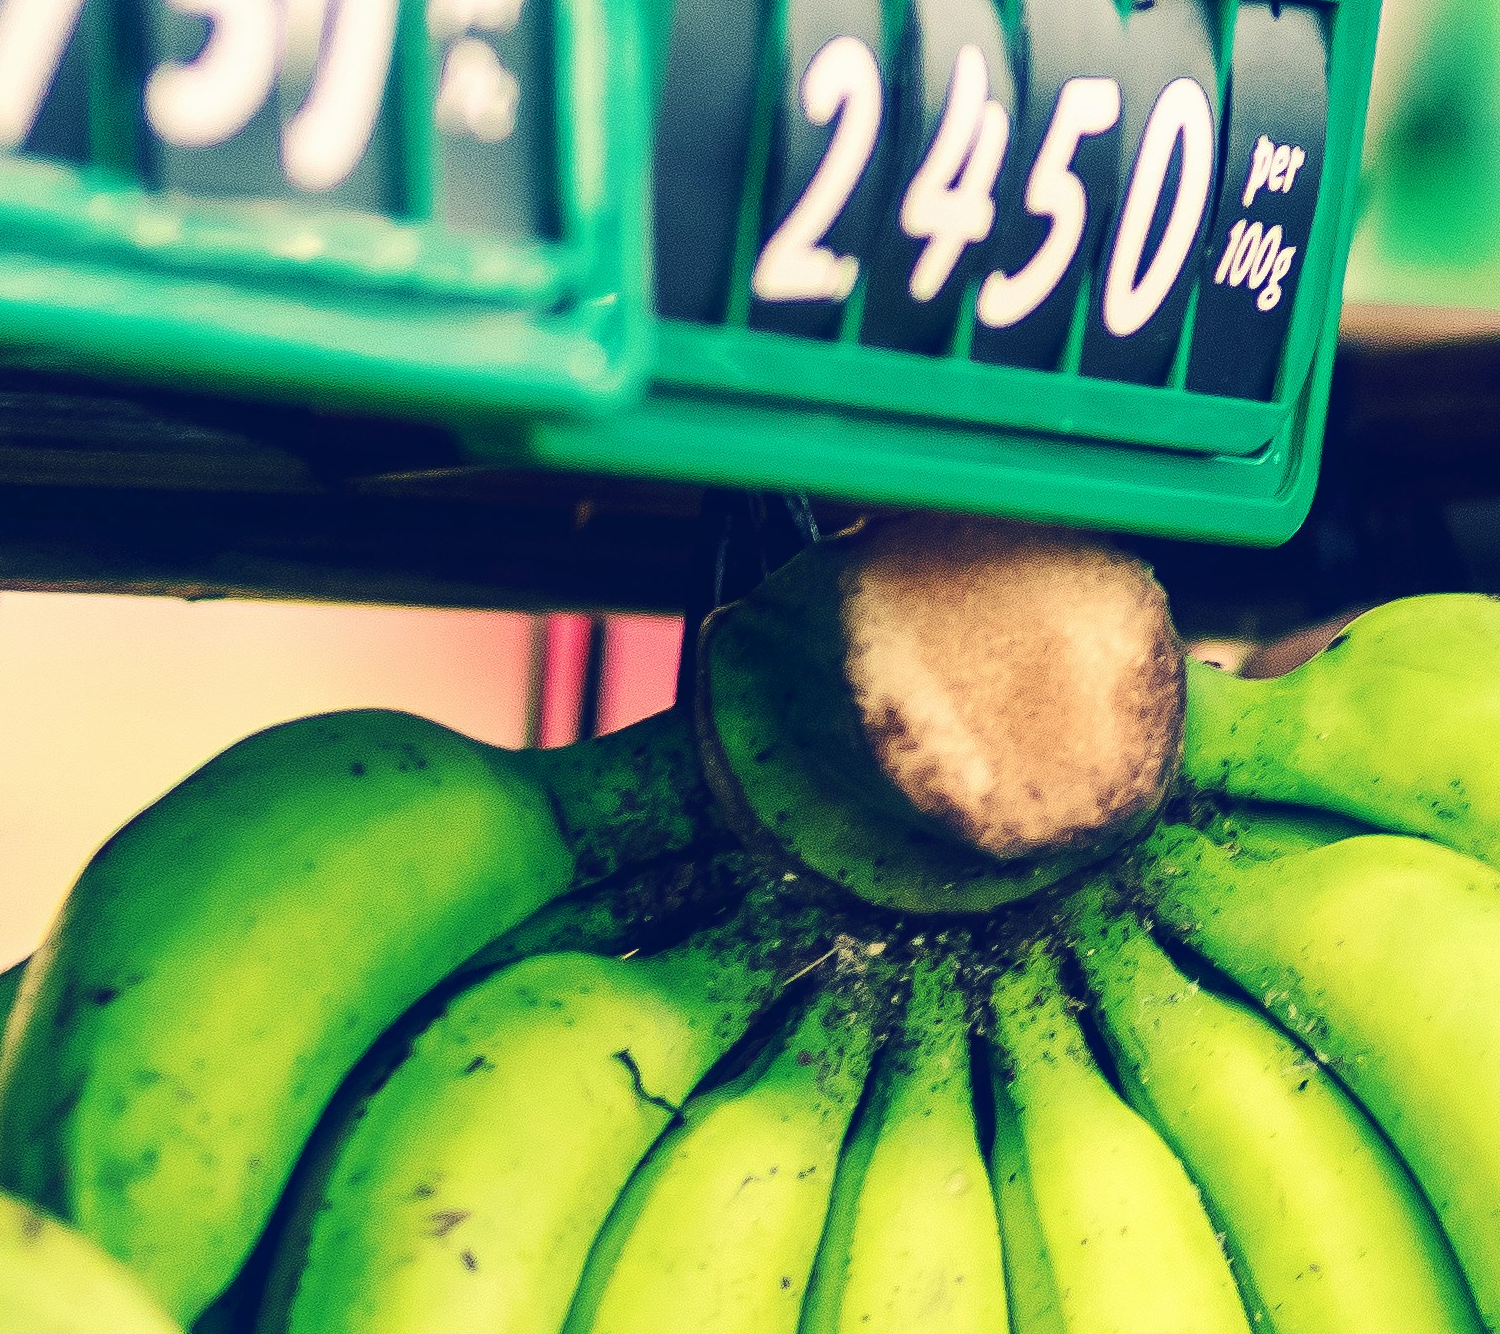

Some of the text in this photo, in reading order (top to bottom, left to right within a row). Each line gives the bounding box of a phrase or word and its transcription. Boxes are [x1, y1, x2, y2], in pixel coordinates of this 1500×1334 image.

[750, 34, 1217, 339] 2450
[1241, 133, 1306, 209] per
[1212, 217, 1297, 312] 100g
